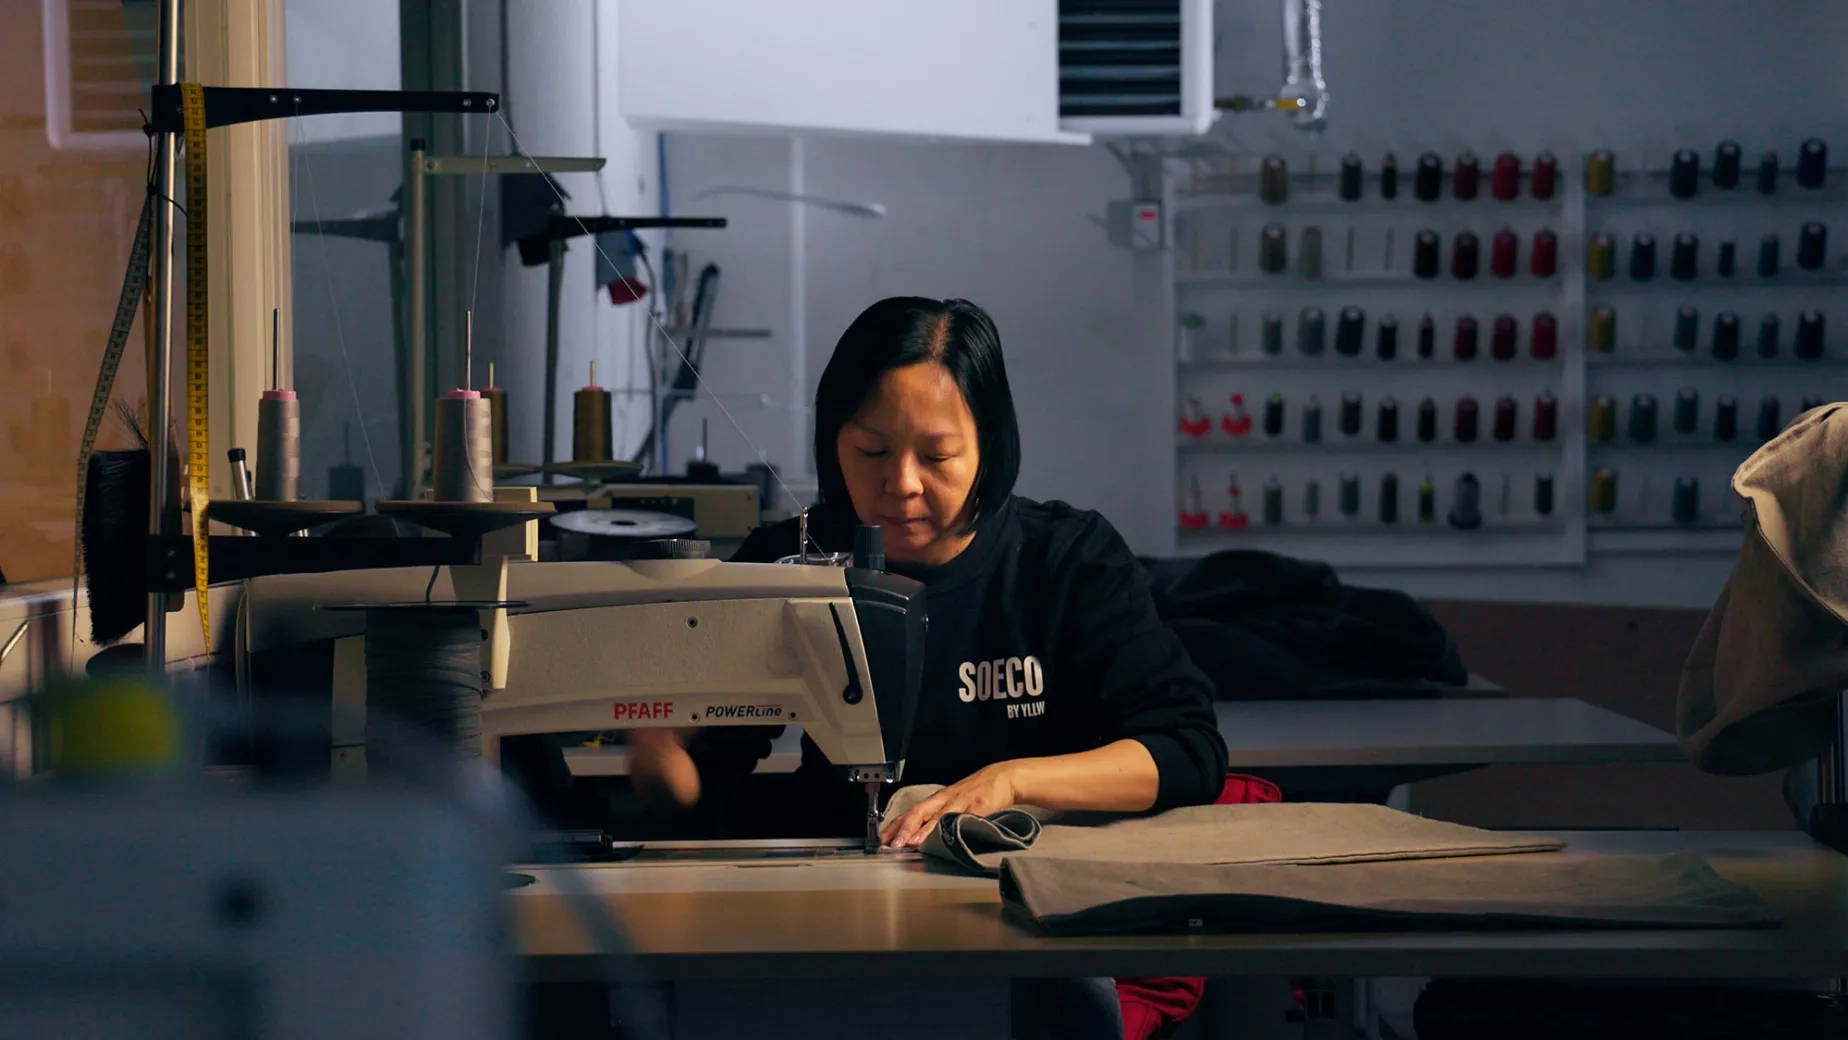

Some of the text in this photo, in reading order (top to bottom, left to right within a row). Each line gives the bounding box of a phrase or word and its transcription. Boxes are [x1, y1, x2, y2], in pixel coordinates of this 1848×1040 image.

[958, 655, 1044, 703] SOECO
[614, 702, 674, 720] PFAFF
[1007, 700, 1046, 719] BY YLLW
